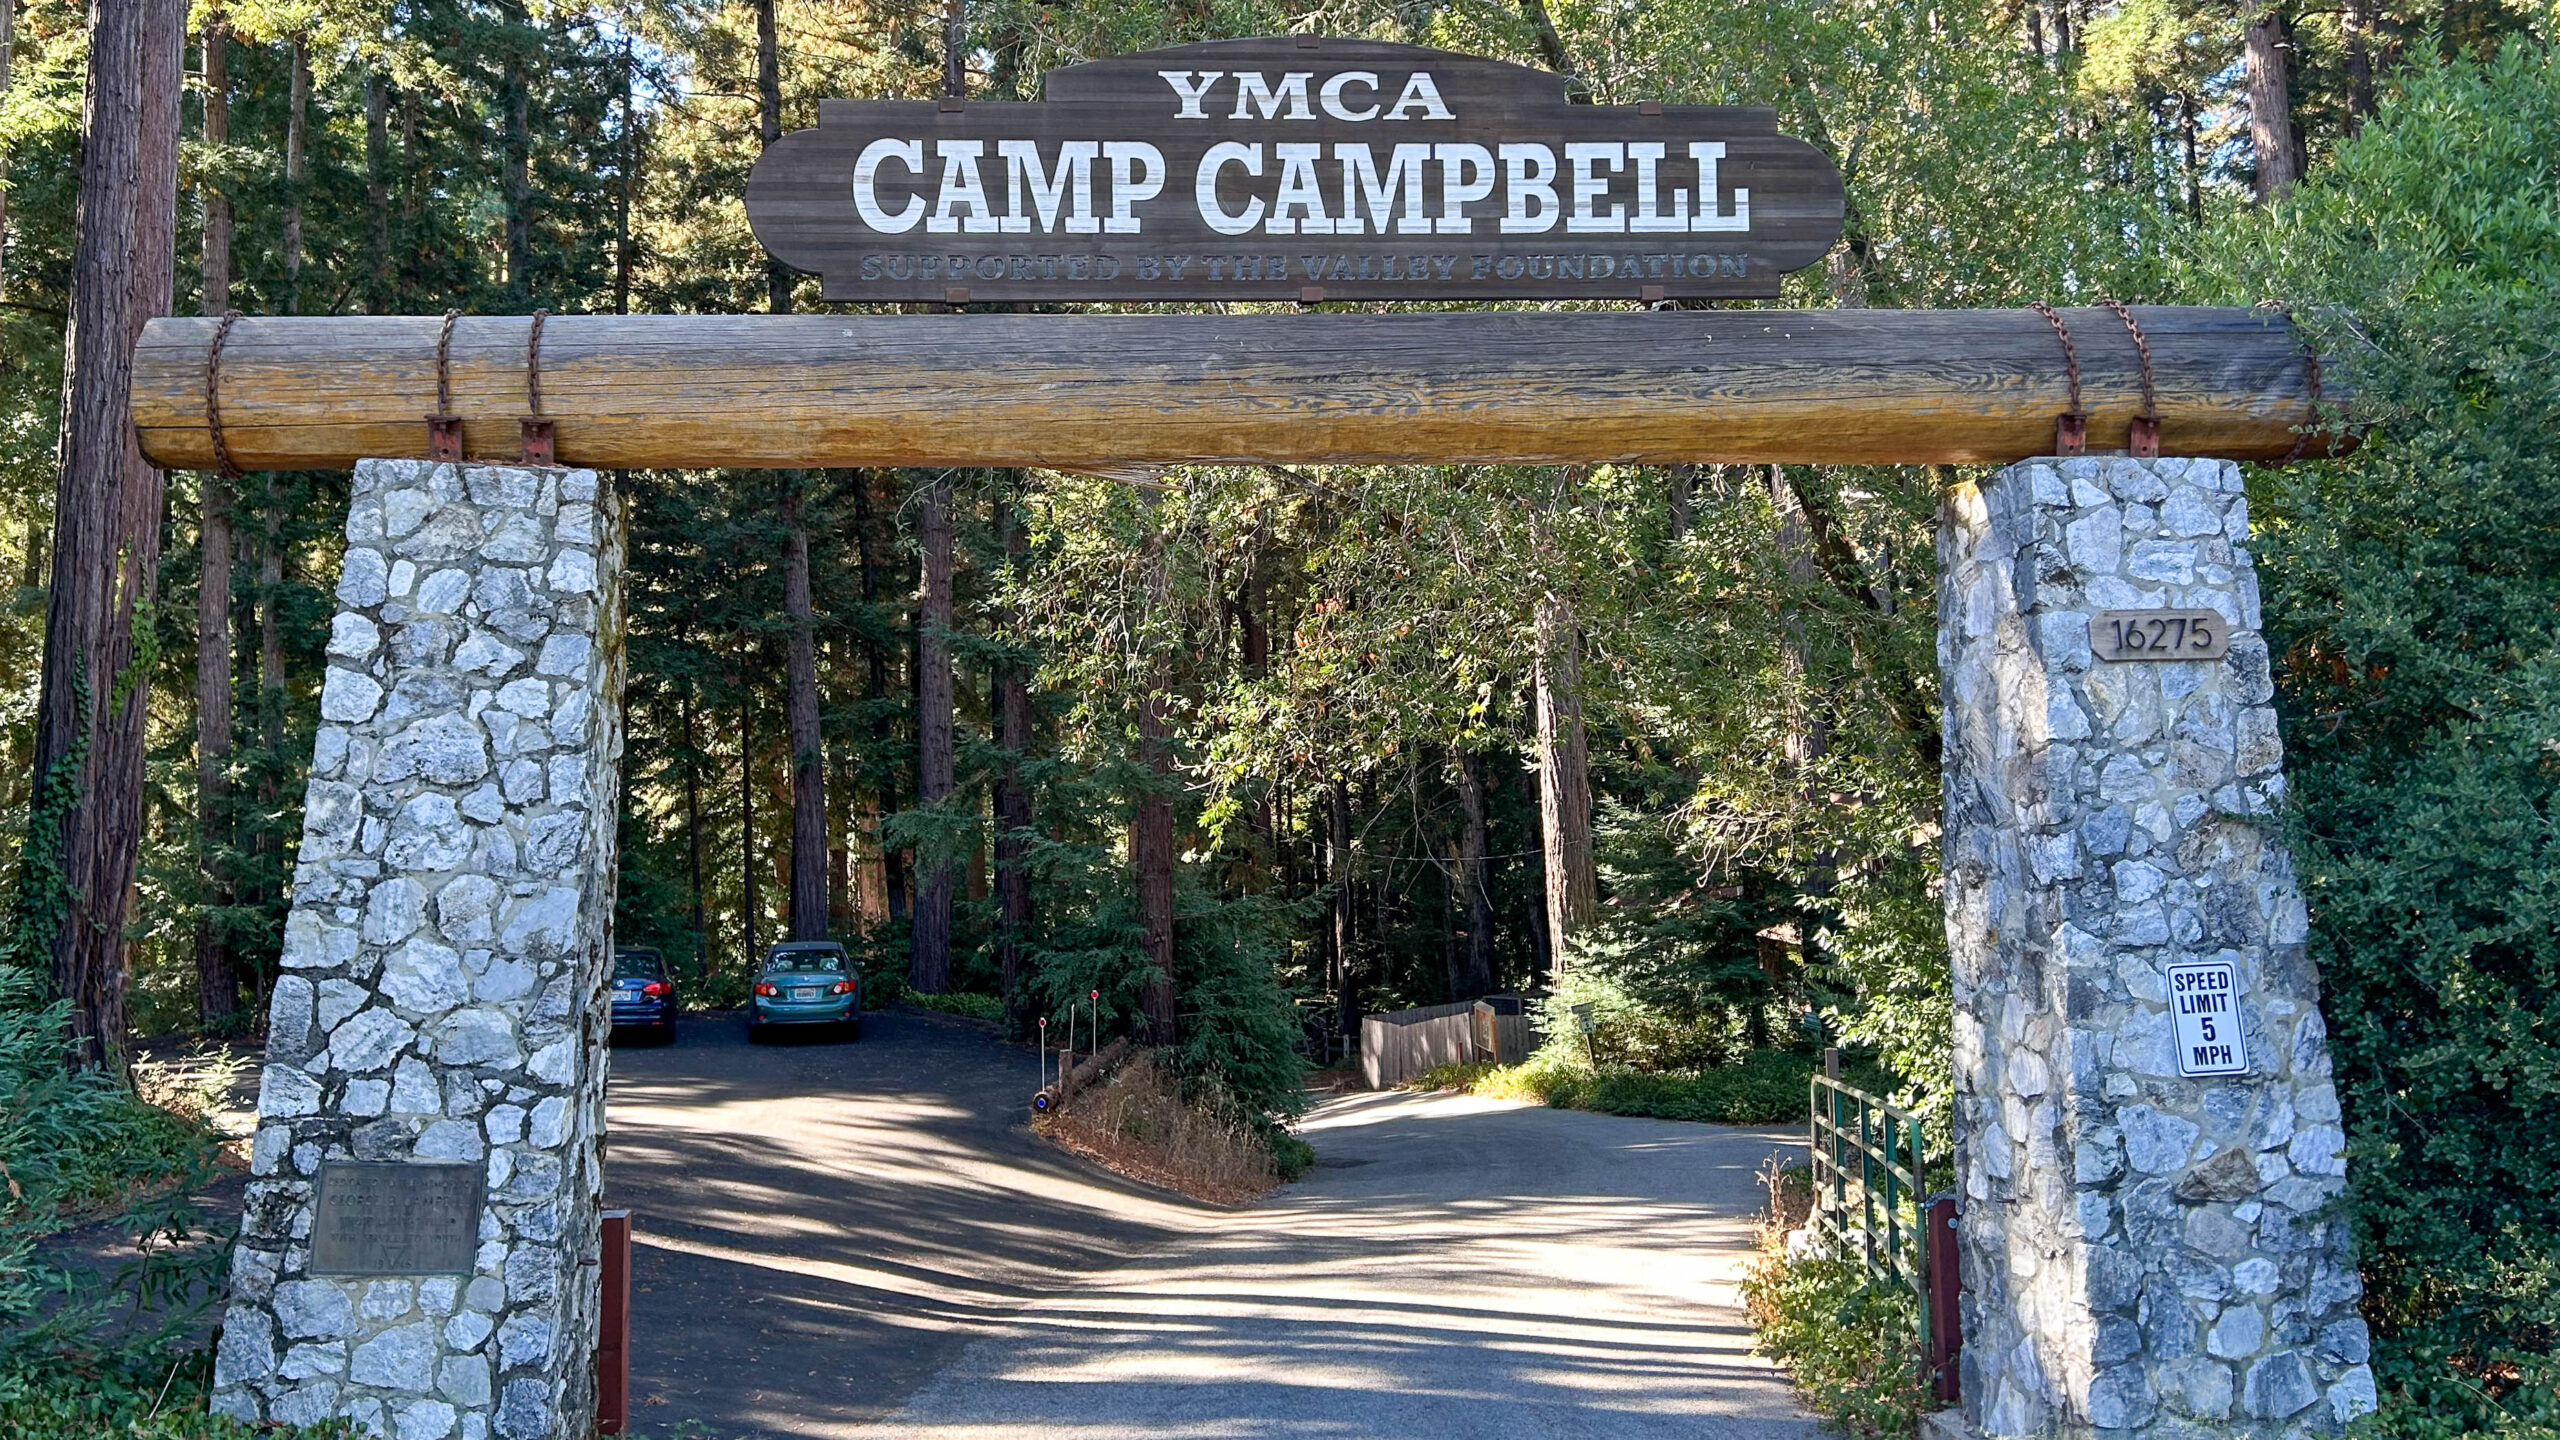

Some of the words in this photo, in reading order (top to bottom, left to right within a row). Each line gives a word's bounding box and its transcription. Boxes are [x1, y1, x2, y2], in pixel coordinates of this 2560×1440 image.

[1158, 70, 1457, 121] YMCA
[852, 138, 1167, 235] CAMP
[1195, 140, 1750, 236] CAMPBELL
[859, 254, 1121, 281] SUPPORTED
[1135, 254, 1191, 281] BY
[1201, 254, 1289, 281] THE
[1300, 254, 1459, 281] VALLEY
[1470, 253, 1750, 281] FOUNDATION
[2112, 618, 2213, 651] 16275
[2174, 971, 2229, 992] SPEED
[2180, 993, 2227, 1014] LIMIT
[2201, 1017, 2216, 1042] 5
[2193, 1045, 2233, 1066] MPH
[402, 1195, 472, 1208] AMPBLL
